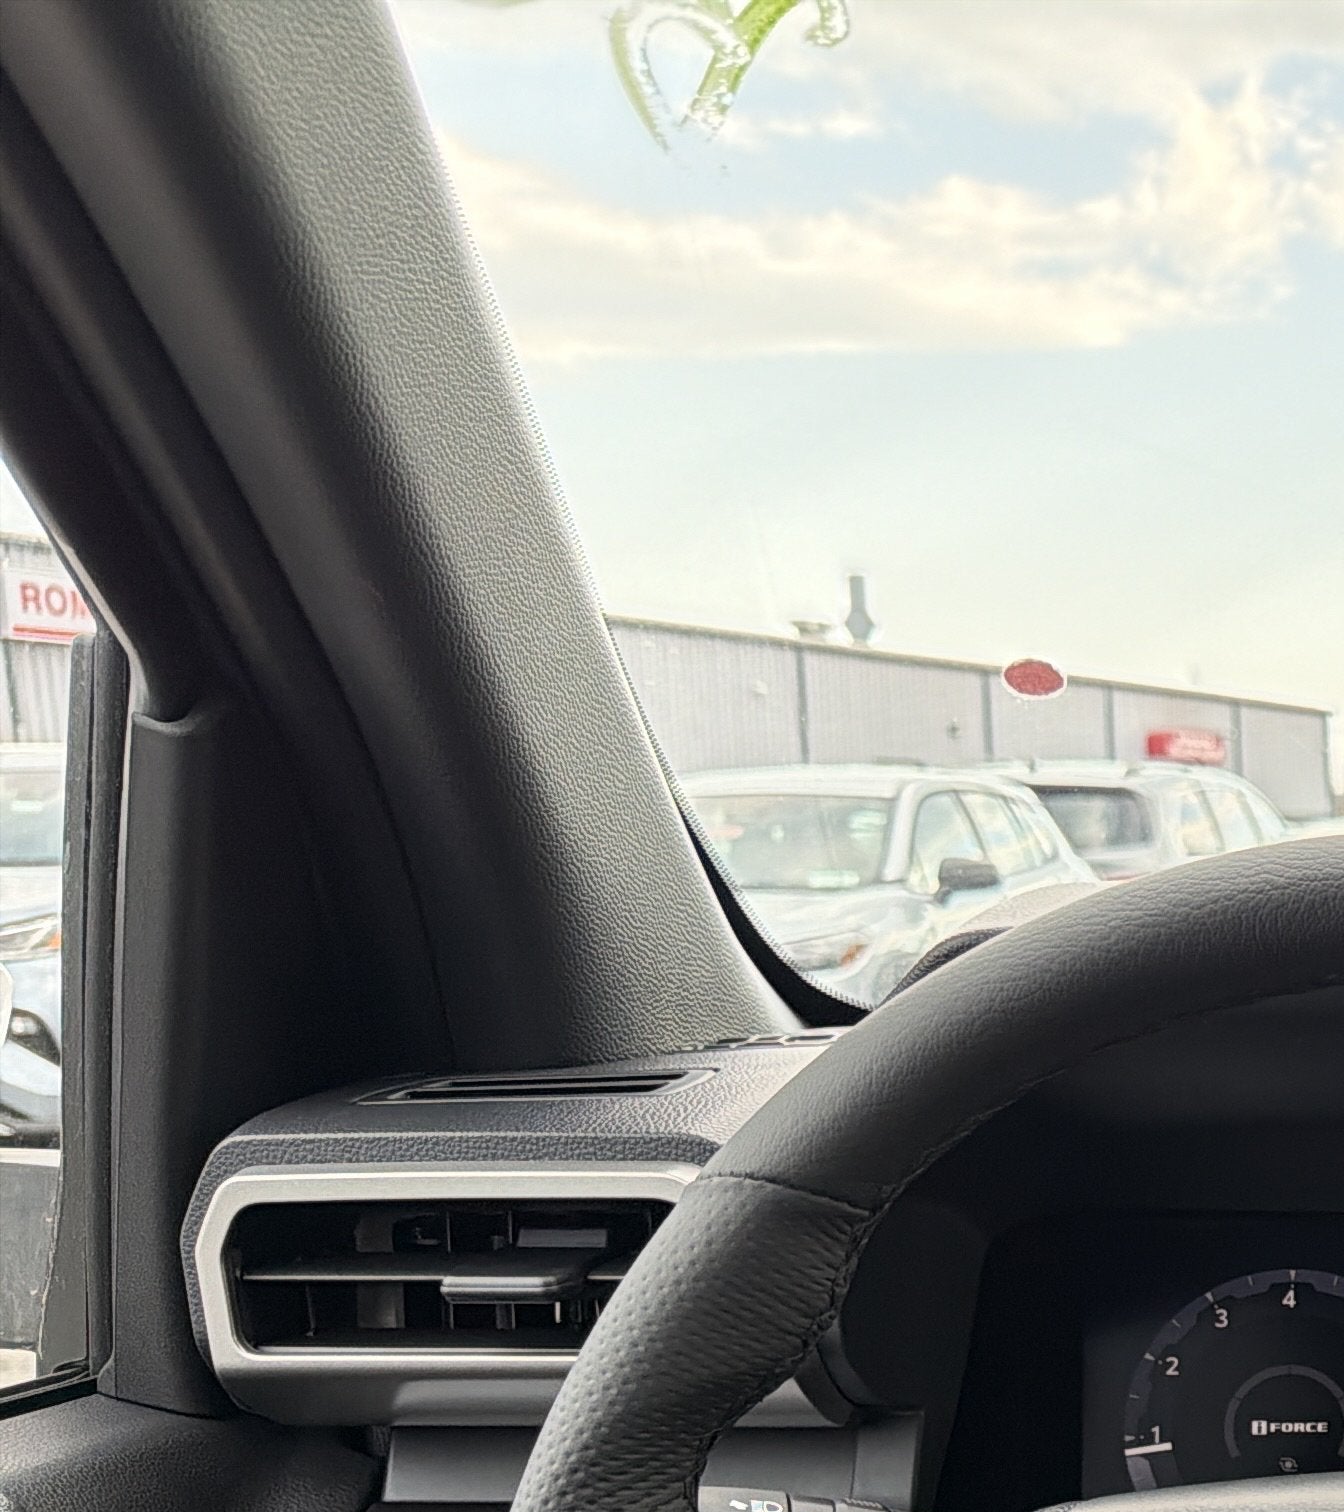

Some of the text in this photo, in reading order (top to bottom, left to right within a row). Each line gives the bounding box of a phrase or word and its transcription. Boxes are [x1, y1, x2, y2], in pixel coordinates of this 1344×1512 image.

[1281, 1289, 1297, 1309] 4
[1214, 1307, 1229, 1328] 3
[1165, 1357, 1180, 1376] 2
[1150, 1425, 1161, 1444] 1
